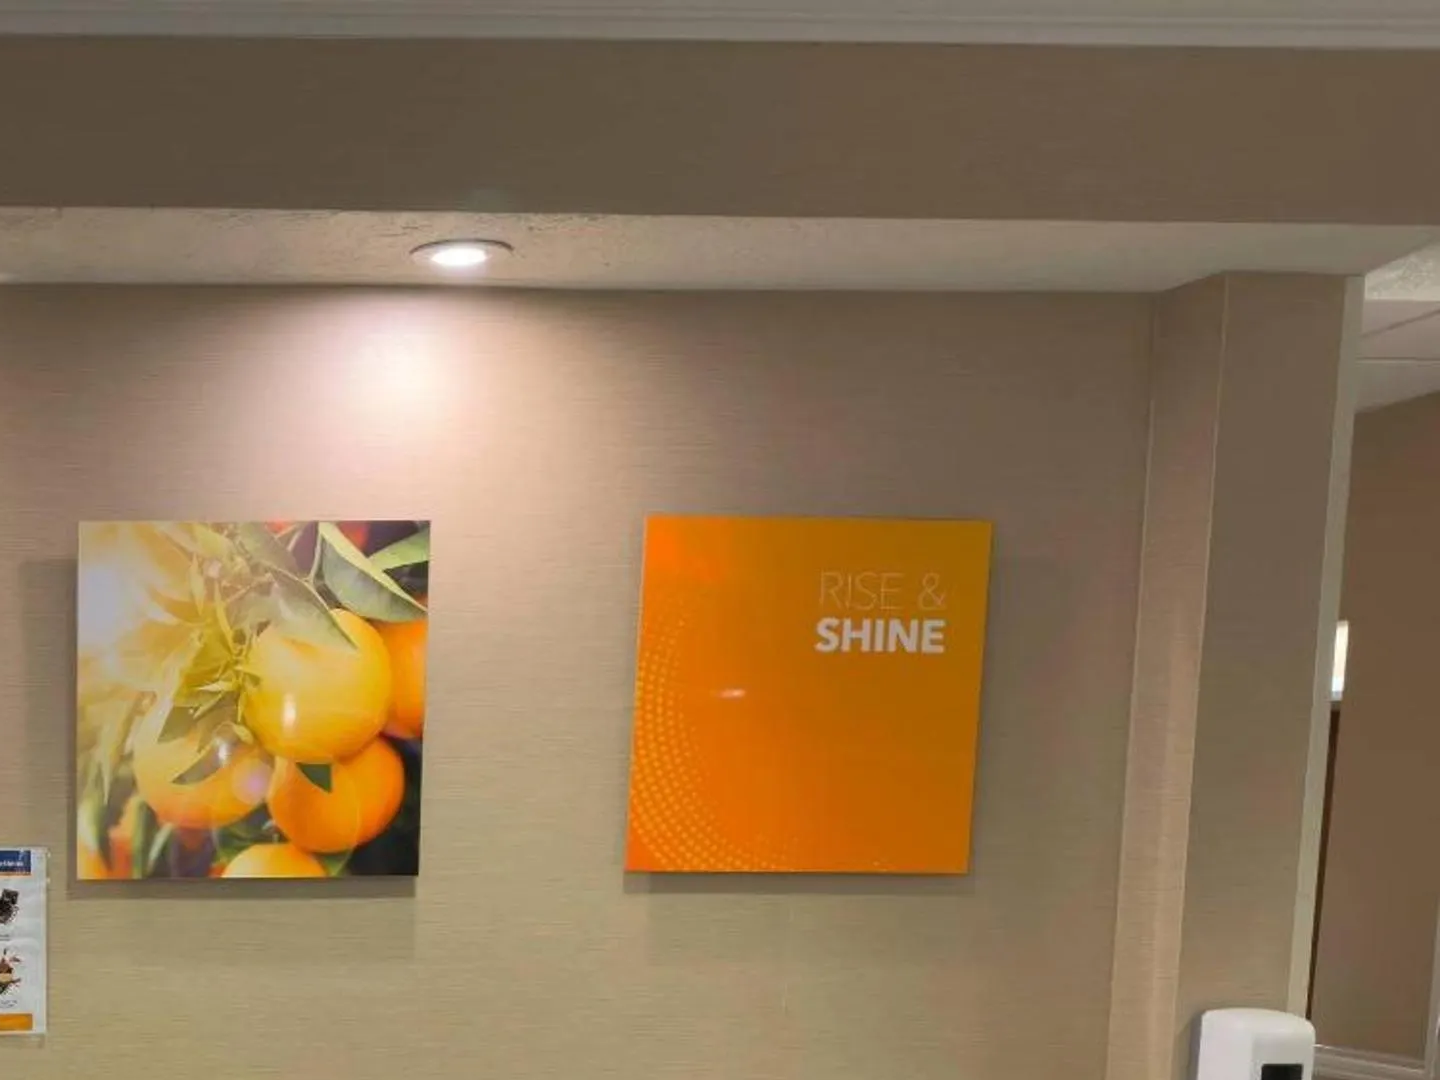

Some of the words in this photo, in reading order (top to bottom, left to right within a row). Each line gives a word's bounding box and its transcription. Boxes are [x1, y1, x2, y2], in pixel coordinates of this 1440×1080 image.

[818, 571, 904, 610] RISE
[918, 572, 947, 611] &
[815, 616, 946, 653] SHINE
